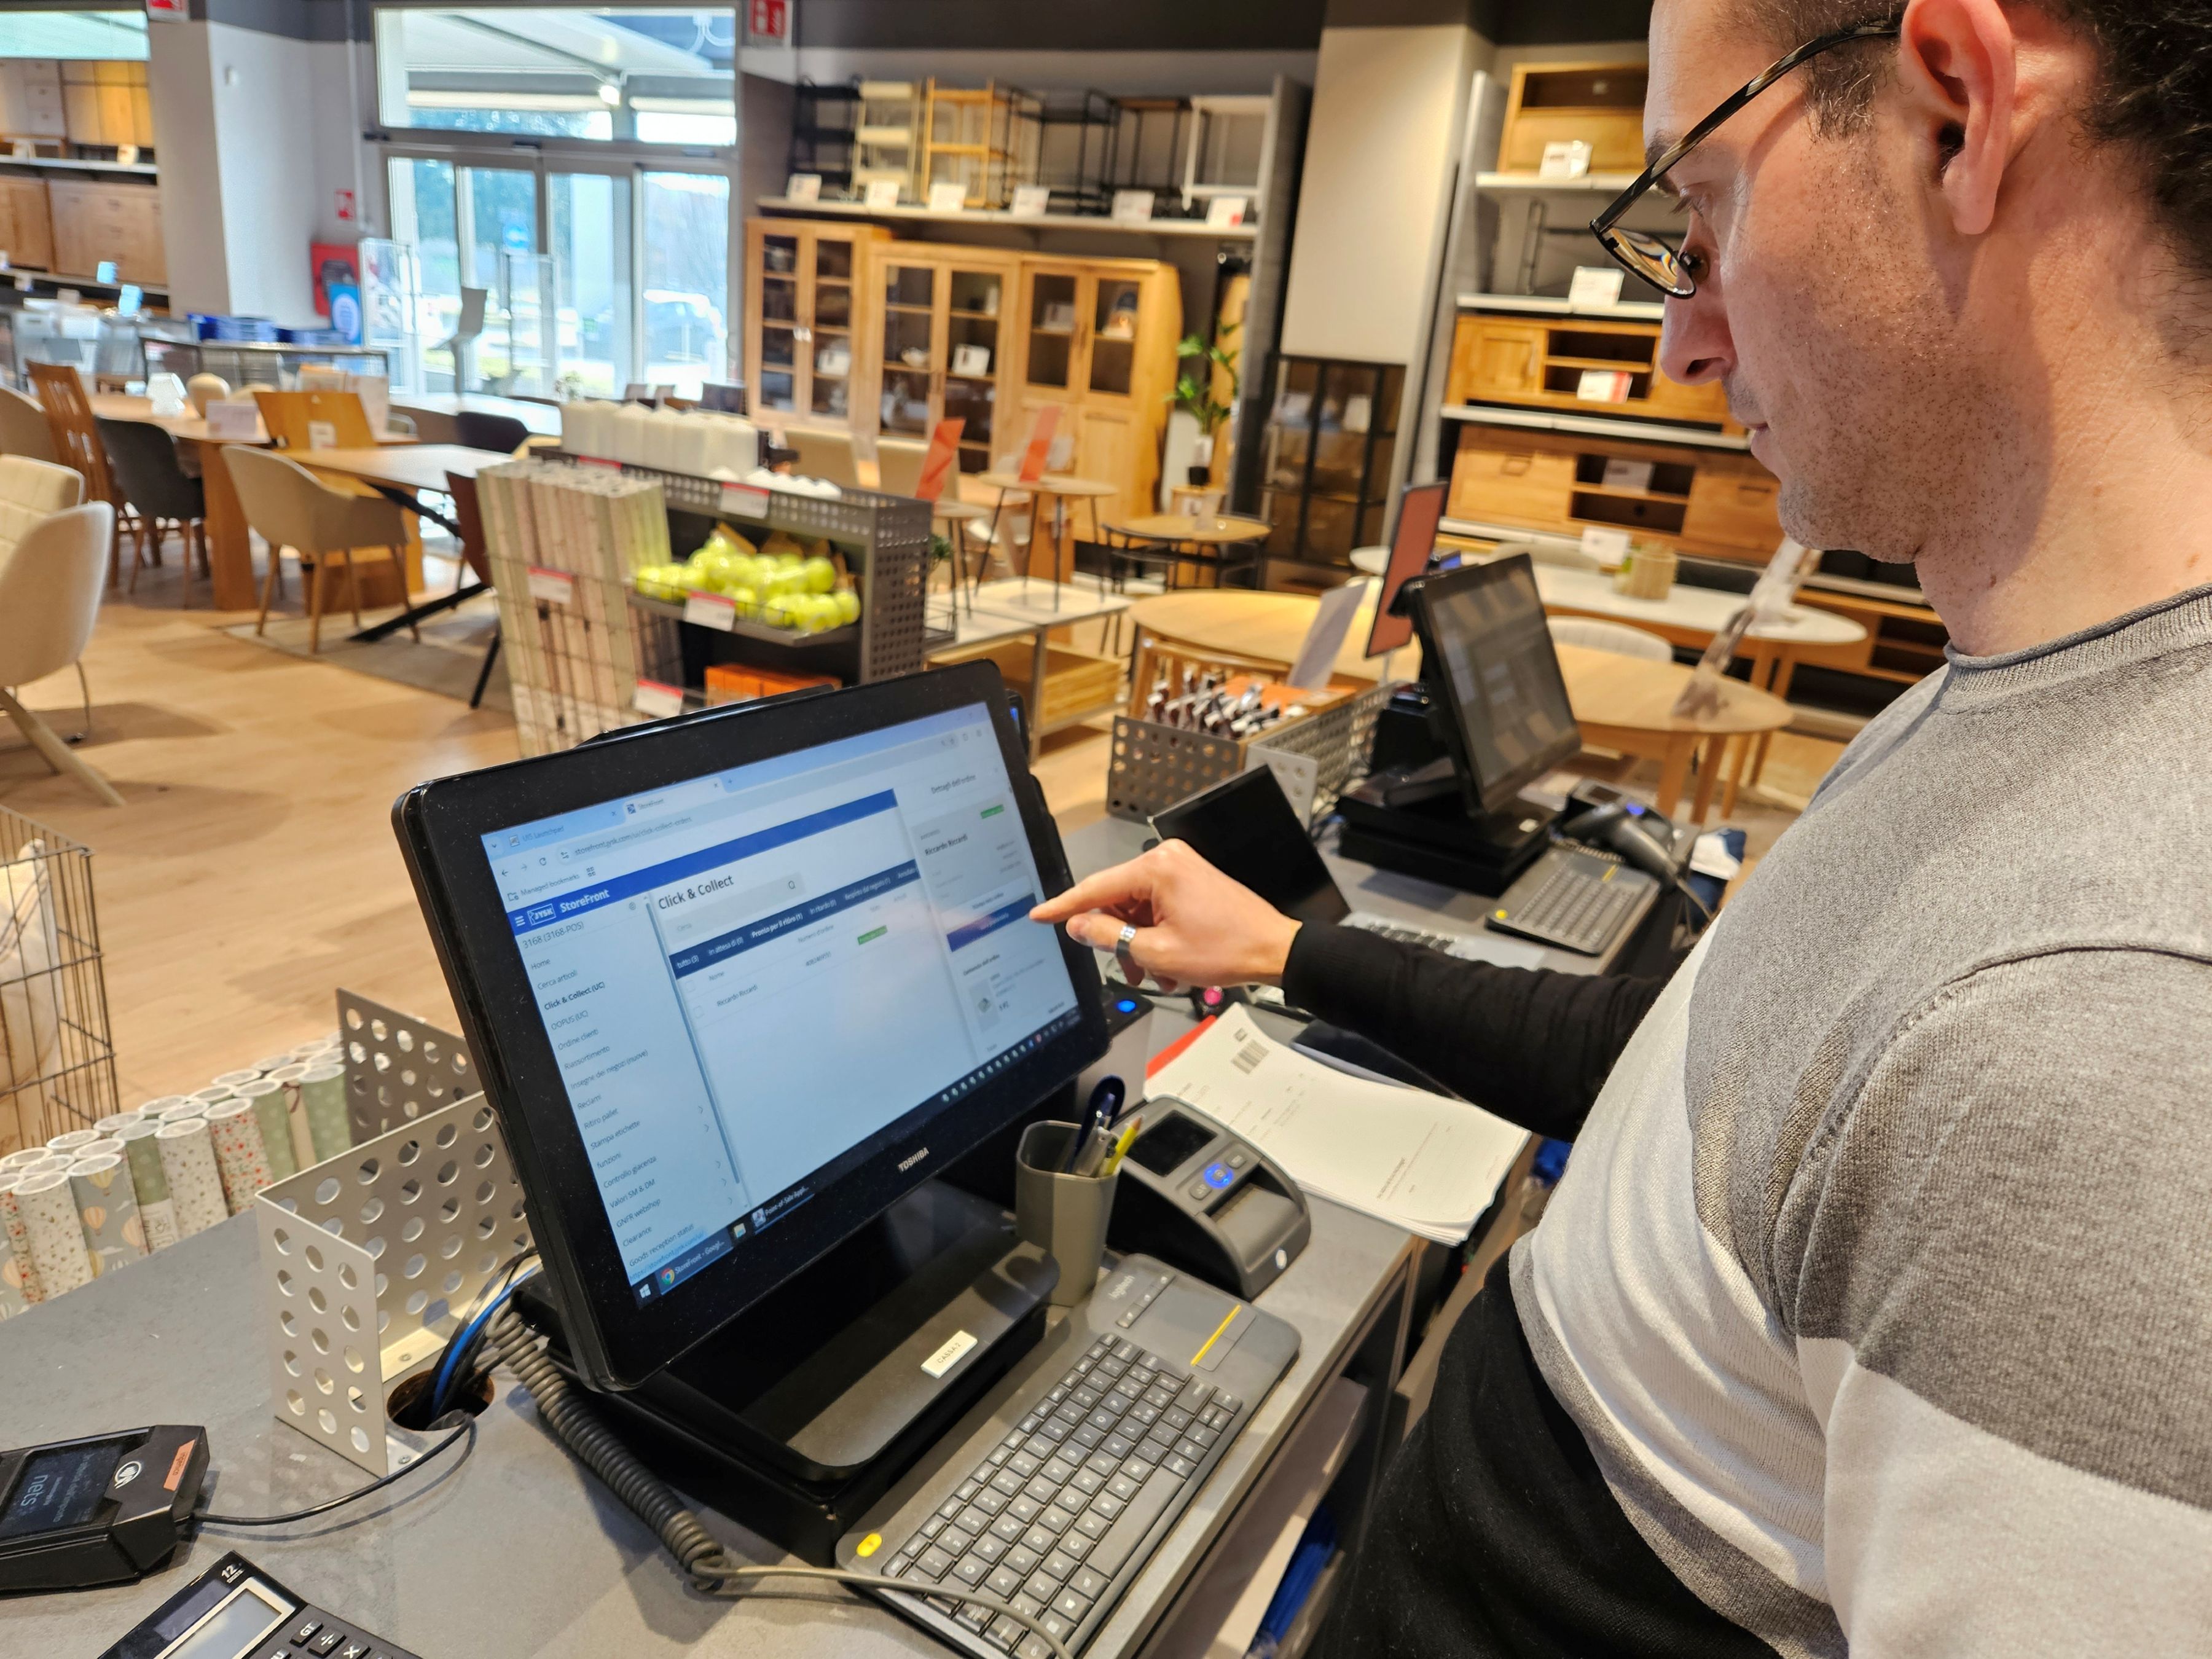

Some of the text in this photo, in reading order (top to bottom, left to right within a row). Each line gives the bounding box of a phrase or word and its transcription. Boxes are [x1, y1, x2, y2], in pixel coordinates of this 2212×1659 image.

[520, 873, 579, 897] Managed bookmarks
[658, 875, 734, 909] Click & Collect
[560, 889, 610, 913] StoreFront
[533, 908, 554, 921] JYSK
[523, 921, 584, 949] 3168 (3168-POS)
[531, 958, 551, 970] Home
[538, 969, 578, 990] Cerca articoli
[544, 998, 560, 1010] Click
[568, 987, 591, 1001] Collect
[592, 981, 605, 992] (UC)
[717, 994, 739, 1006] Riccardo
[576, 1010, 589, 1021] (UC)
[558, 1029, 598, 1050] Ordine clienti
[564, 1046, 610, 1070] Riassortimento
[571, 1075, 595, 1090] Insegne
[606, 1061, 626, 1074] negozi
[627, 1049, 648, 1065] (nuove)
[577, 1094, 602, 1110] Reclami
[584, 1108, 619, 1129] Ritiro pallet
[590, 1121, 640, 1150] Stampa etichette
[597, 1153, 622, 1169] funzioni
[898, 1147, 929, 1172] TOSHIBA
[603, 1156, 657, 1188] Controllo giacenza
[628, 1188, 638, 1199] SM
[645, 1179, 656, 1190] DM
[616, 1199, 661, 1228] GNFR webshop
[623, 1225, 652, 1247] Clearance
[630, 1223, 694, 1267] Goods reception status
[675, 1253, 702, 1274] StoreFront
[937, 1346, 957, 1364] CASSA
[20, 1475, 49, 1507] nets
[222, 1564, 237, 1579] 12
[300, 1622, 315, 1636] GT
